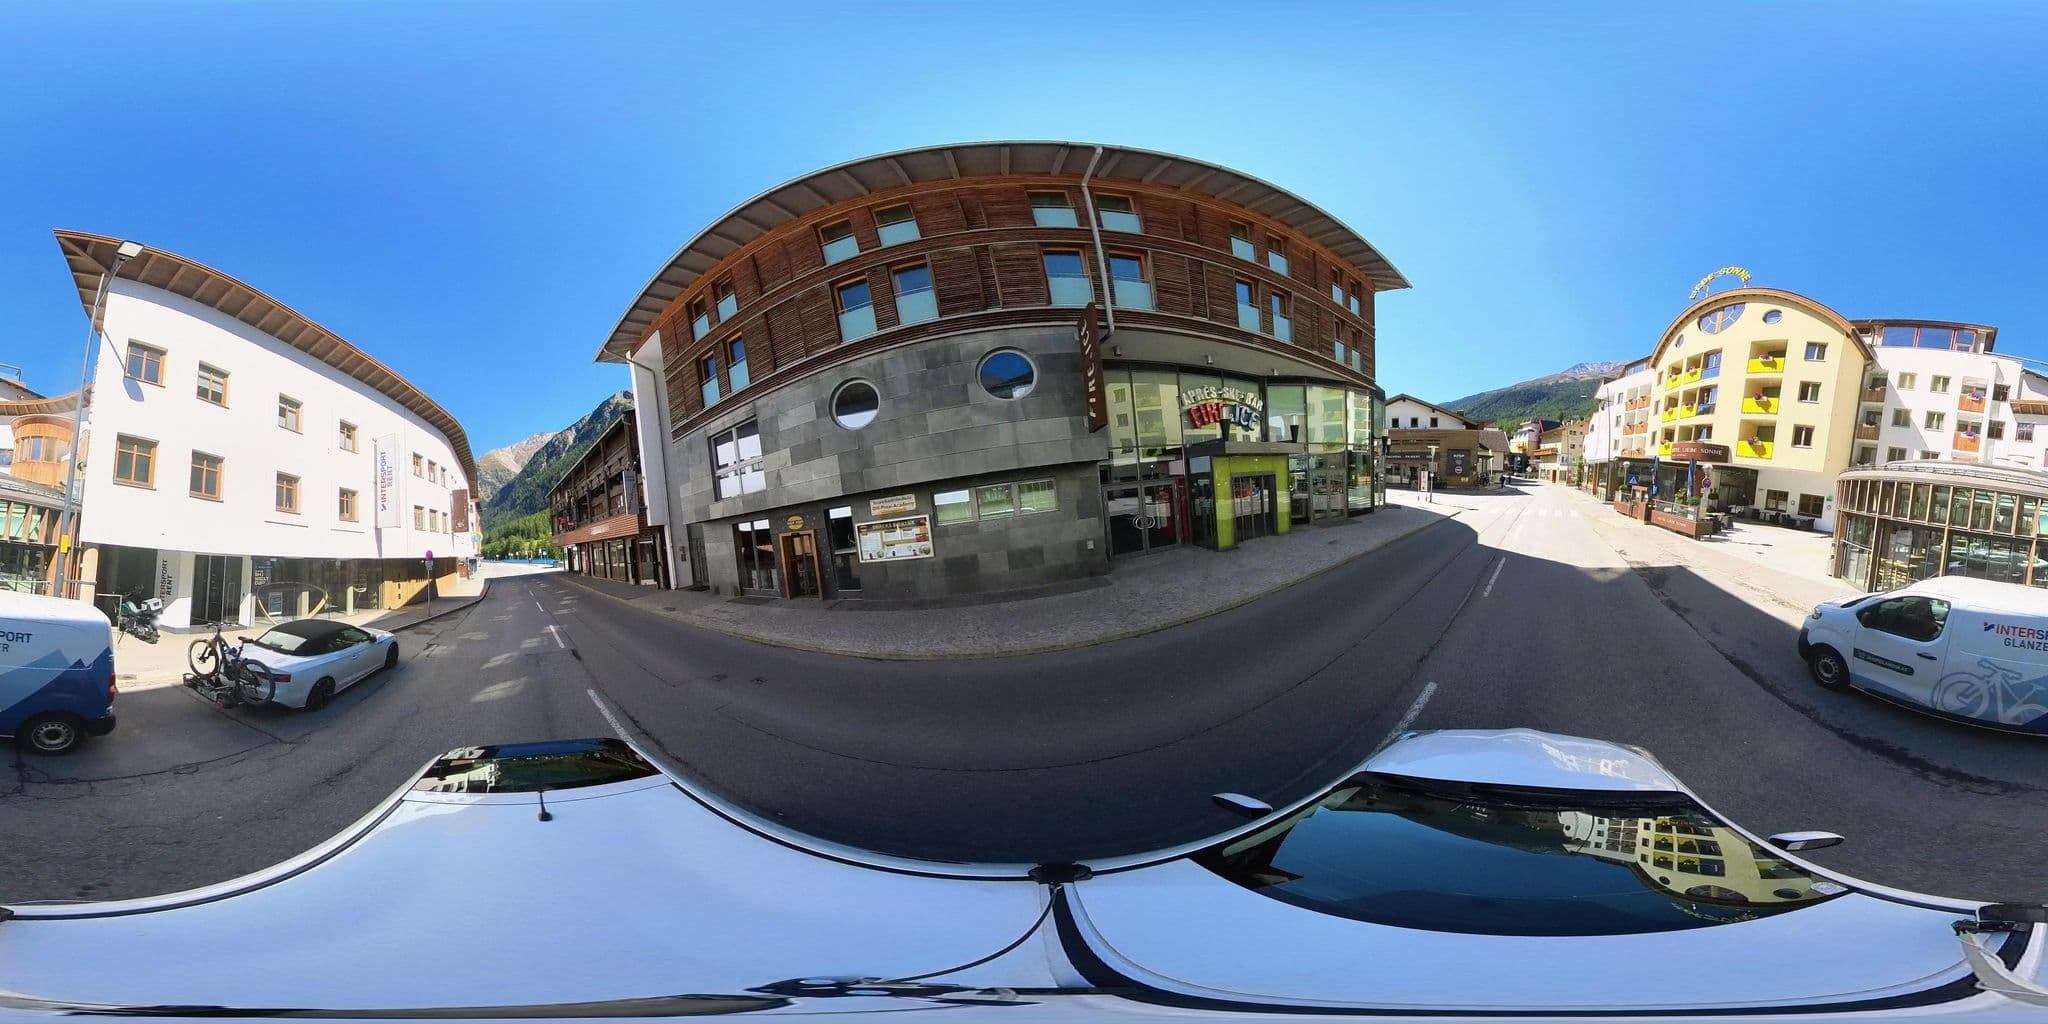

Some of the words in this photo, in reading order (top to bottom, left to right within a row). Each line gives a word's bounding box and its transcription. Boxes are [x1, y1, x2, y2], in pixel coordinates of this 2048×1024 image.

[1719, 266, 1752, 282] SONNE
[1188, 401, 1225, 429] FIR
[1700, 447, 1722, 456] SONNE
[160, 559, 168, 603] TERSPORT
